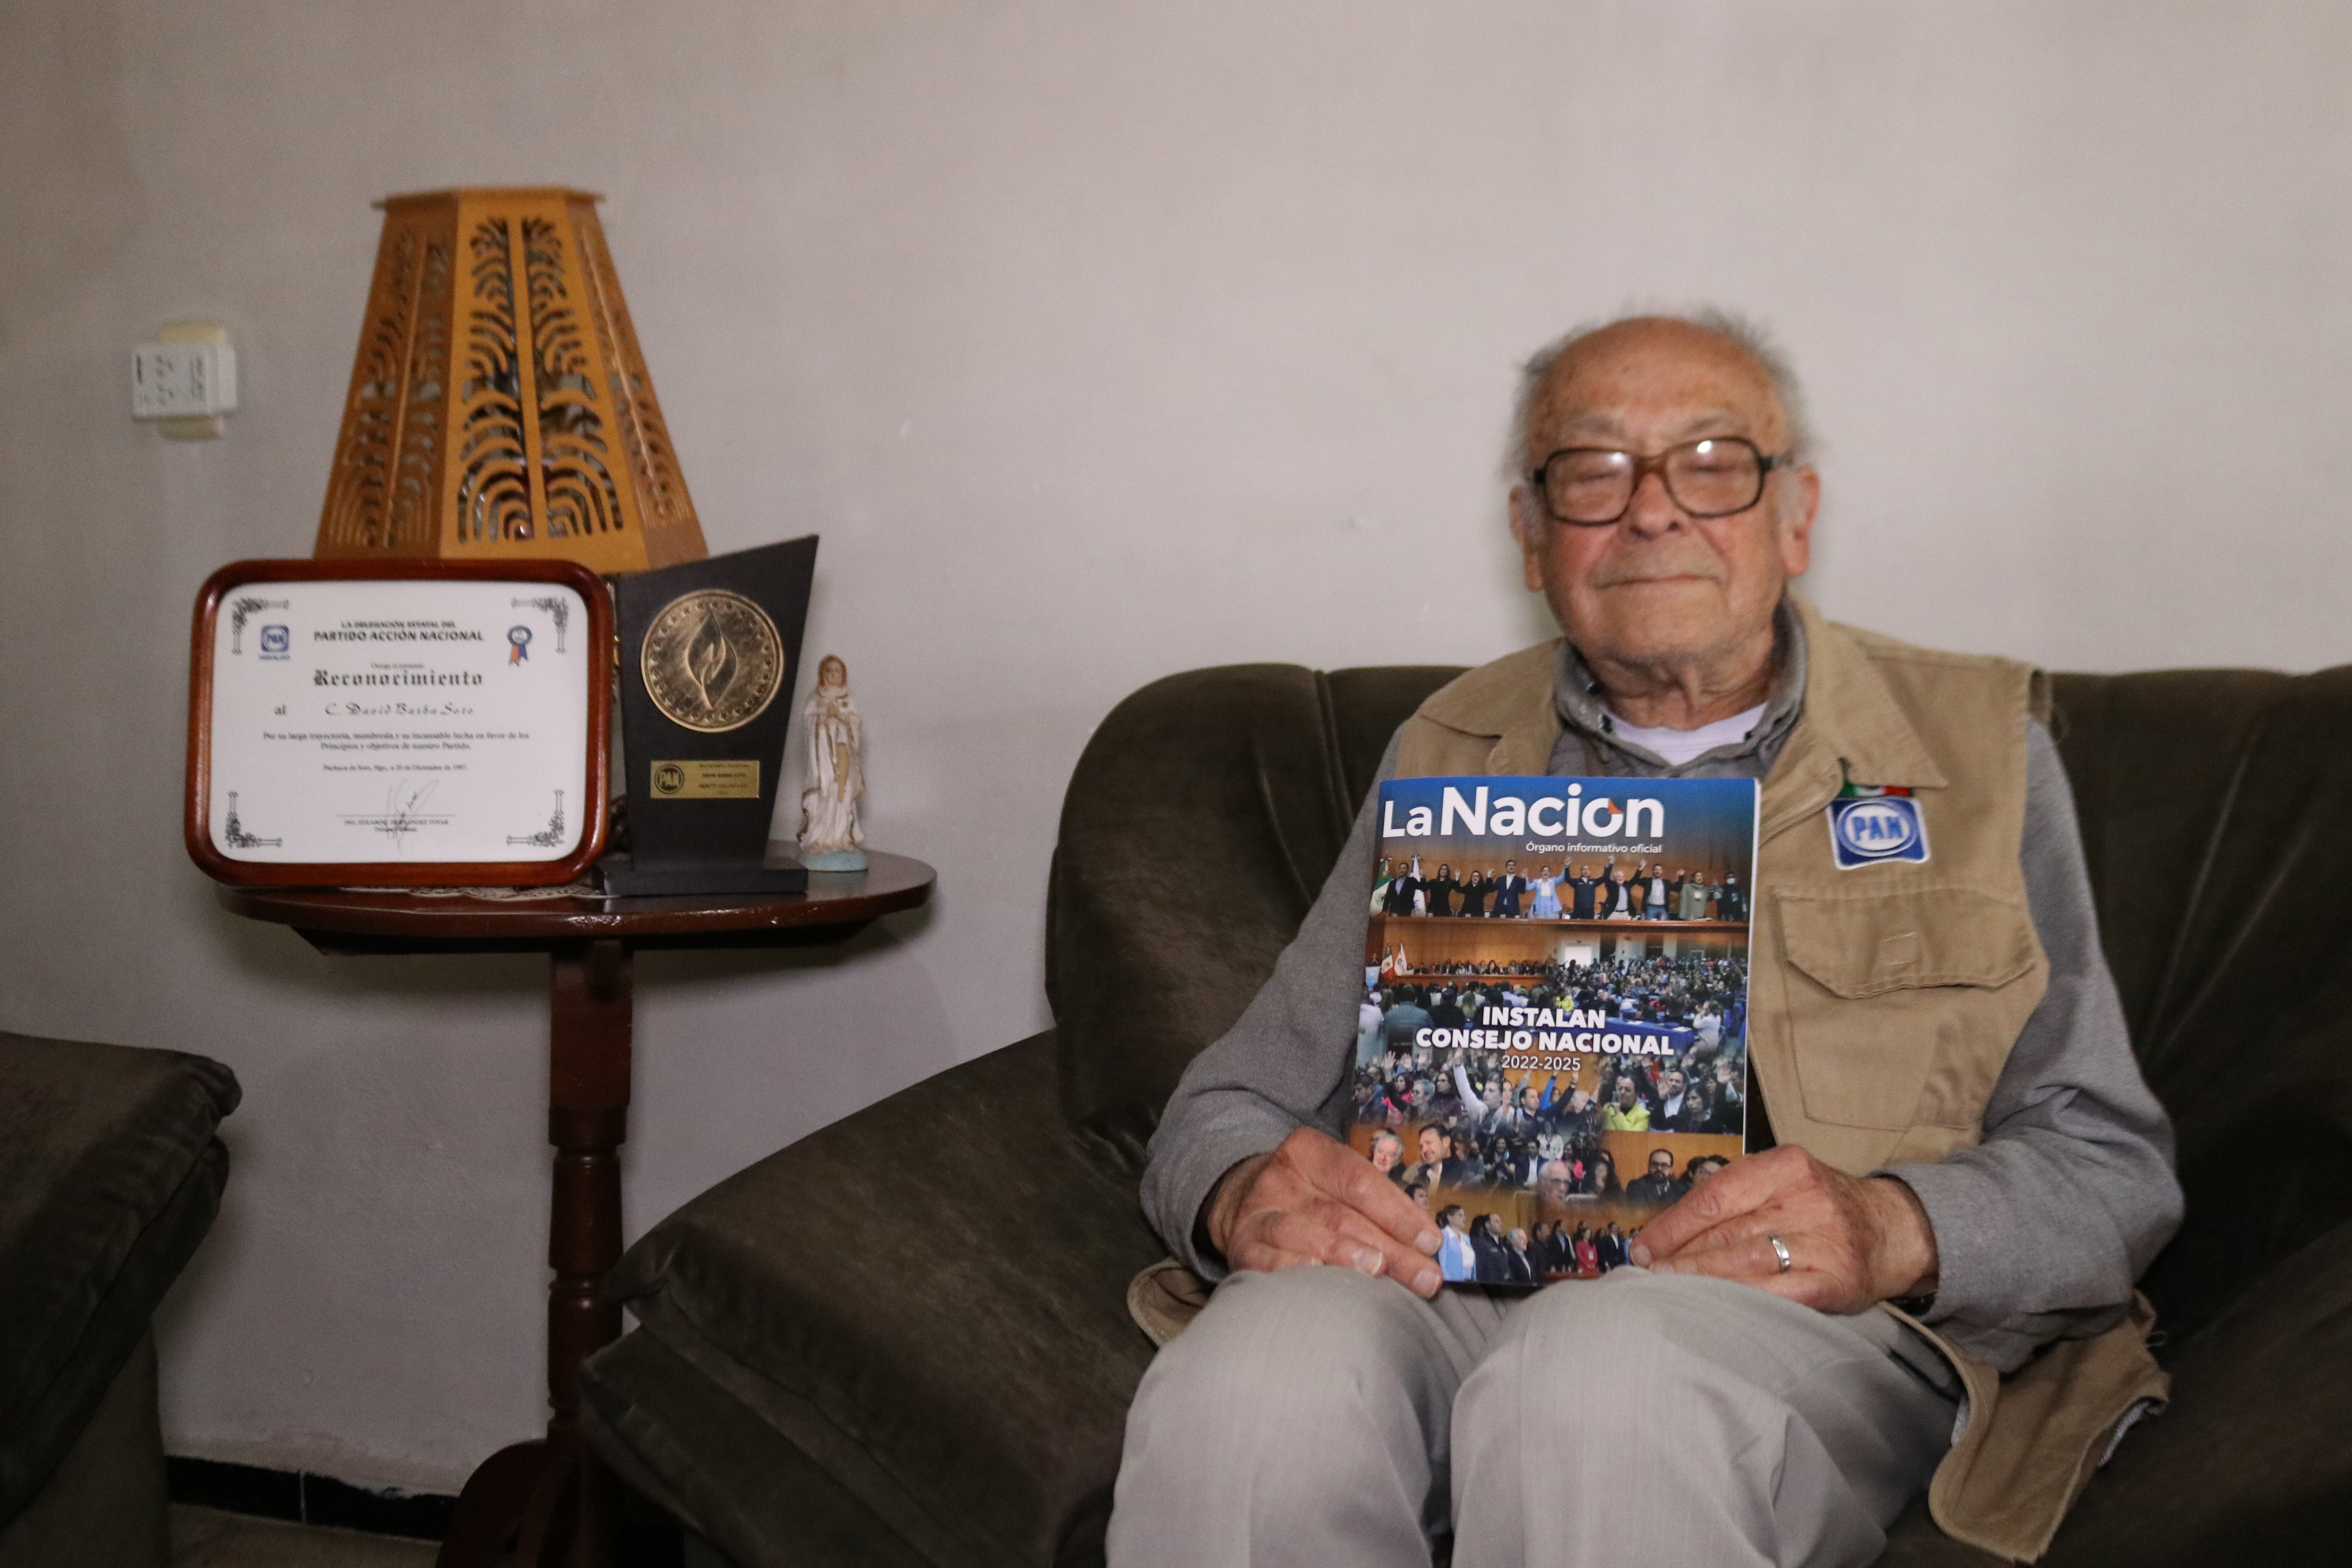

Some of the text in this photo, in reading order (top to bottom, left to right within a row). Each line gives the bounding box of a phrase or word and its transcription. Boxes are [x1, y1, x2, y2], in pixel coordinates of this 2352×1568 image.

[314, 630, 367, 642] PARTIDO
[420, 630, 483, 641] NACIONAL
[313, 669, 483, 686] Reconocimiento
[345, 702, 391, 716] David
[1382, 800, 1433, 838] La
[1851, 816, 1903, 842] PAN
[1525, 840, 1662, 854] Órgano informativo oficial
[1483, 1006, 1606, 1029] INSTALAN
[1416, 1027, 1675, 1056] CONSEJO NACIONAL
[1501, 1054, 1581, 1071] 2022-2025
